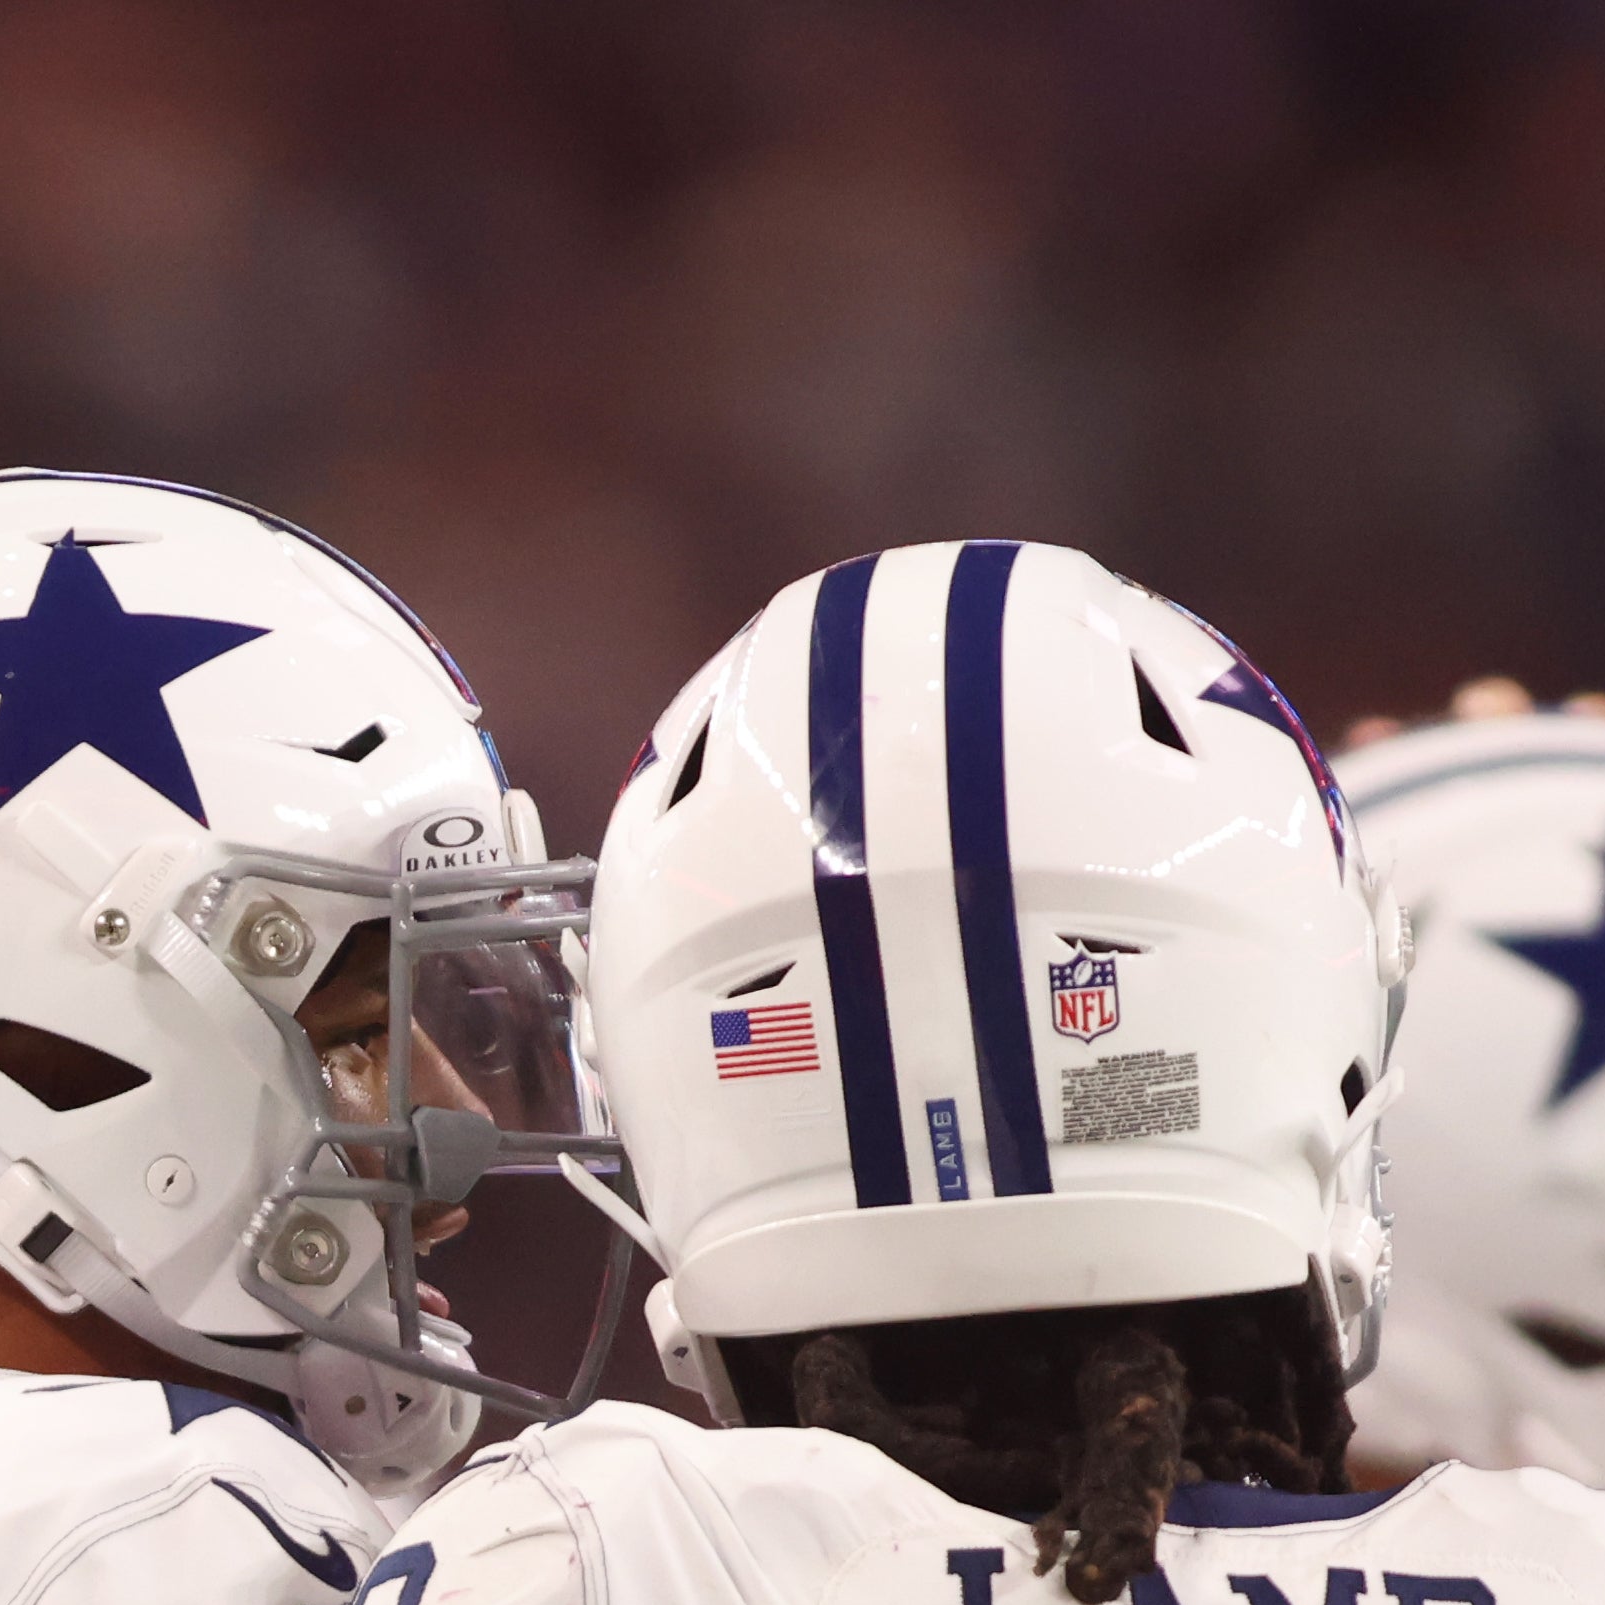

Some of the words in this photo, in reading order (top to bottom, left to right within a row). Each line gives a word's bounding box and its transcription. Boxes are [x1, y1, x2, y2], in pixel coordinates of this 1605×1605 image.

[406, 847, 501, 872] OAKLEY
[1058, 989, 1115, 1034] NFL
[932, 1110, 963, 1189] LAMB
